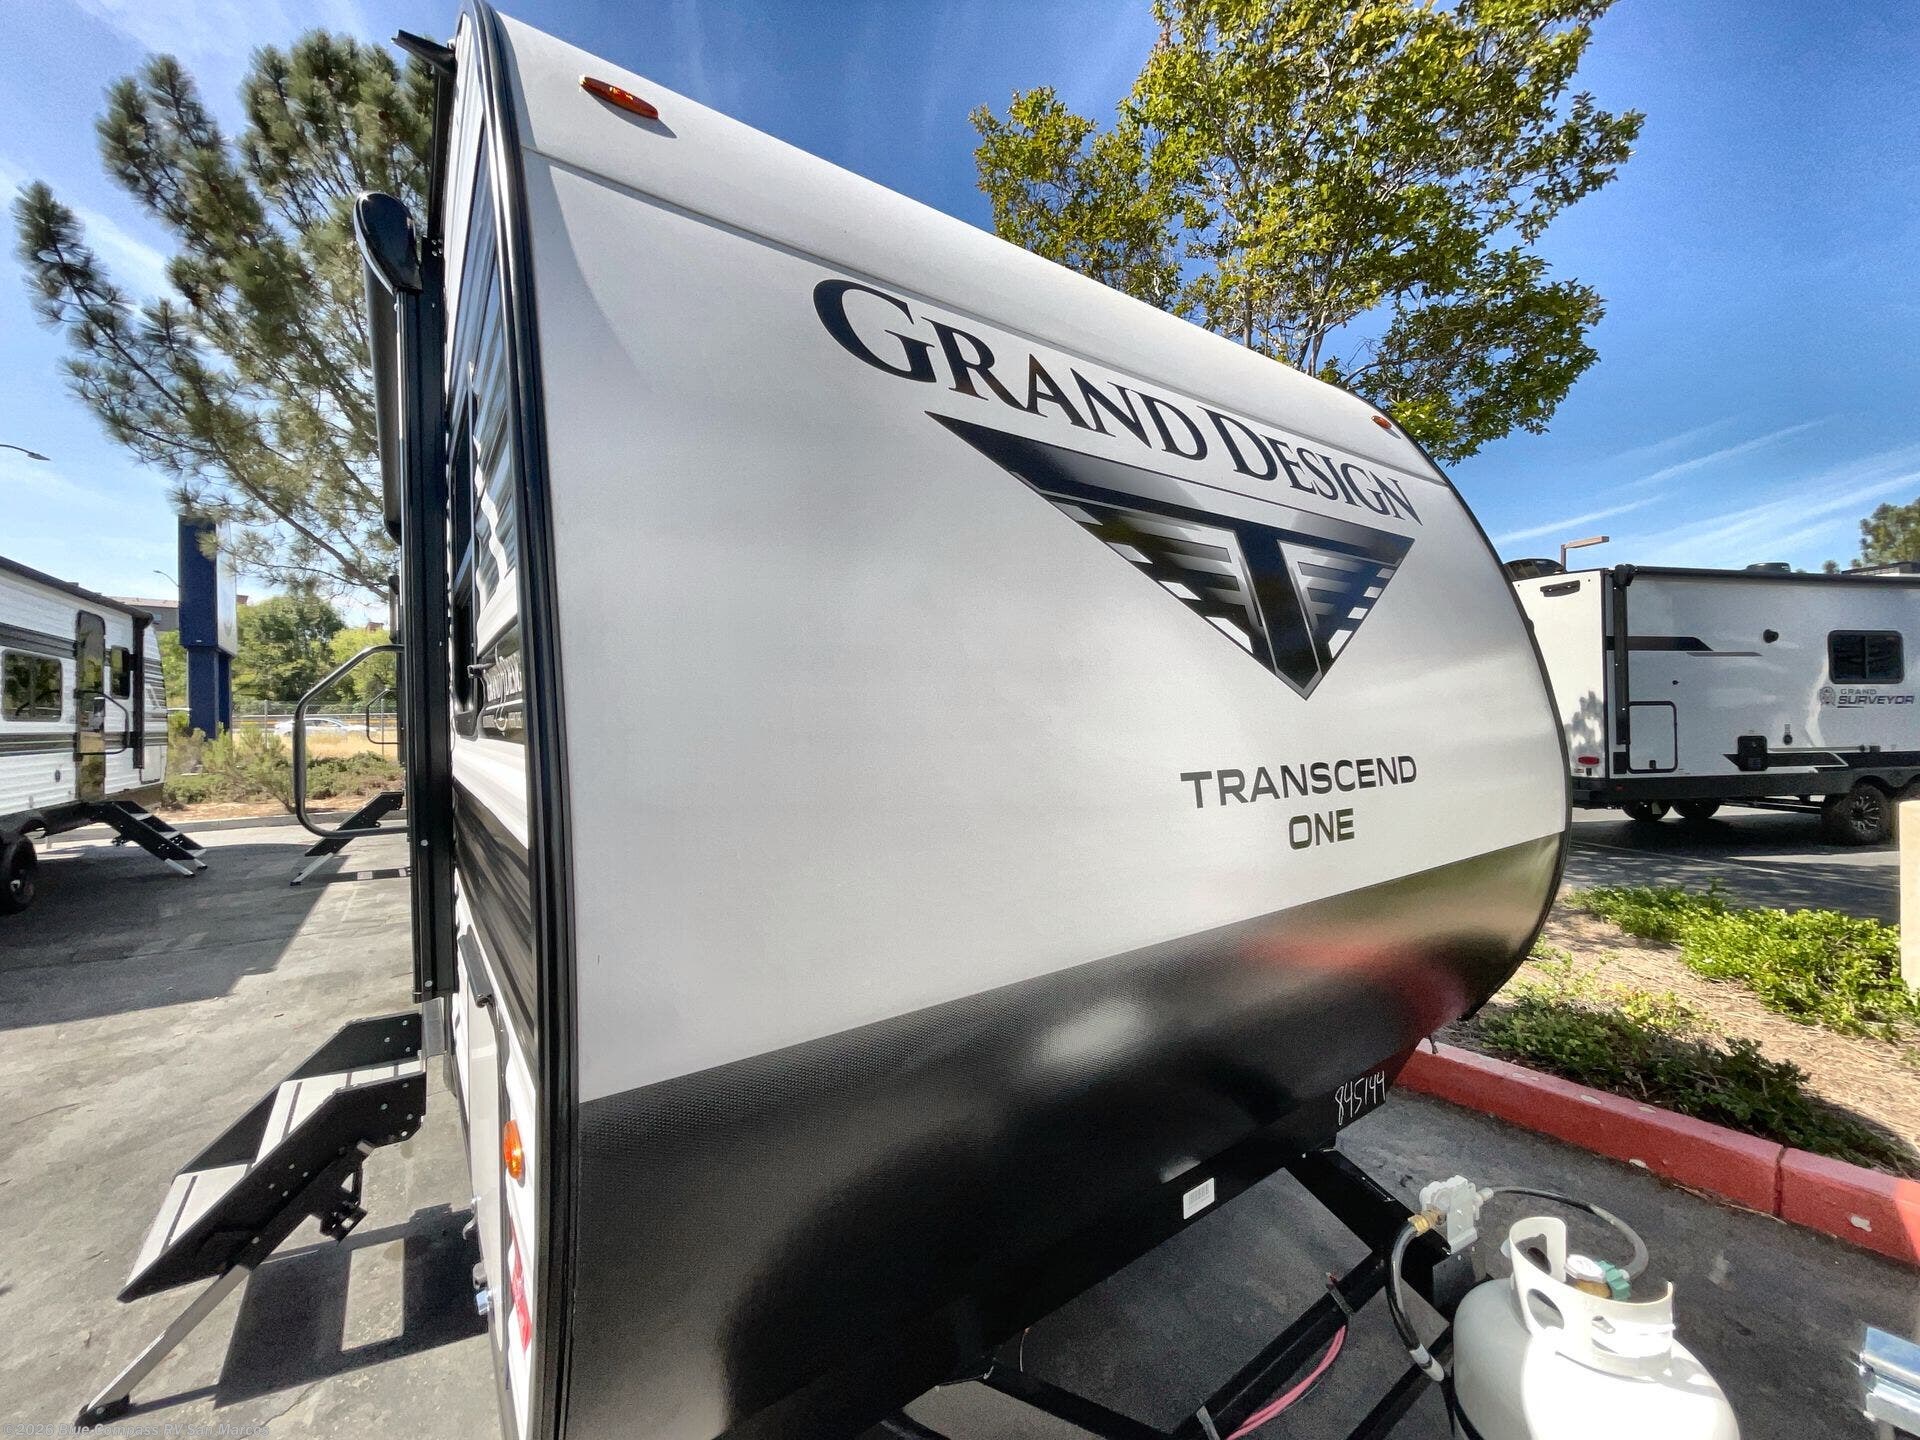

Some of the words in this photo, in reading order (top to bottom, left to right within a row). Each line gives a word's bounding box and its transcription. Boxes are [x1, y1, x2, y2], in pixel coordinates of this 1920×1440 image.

[813, 278, 1209, 461] GRAND
[1196, 405, 1424, 527] DESIGN
[1838, 695, 1916, 705] SURVEYOR
[1180, 755, 1417, 809] TRANSCEND
[1288, 807, 1355, 851] ONE
[1334, 1069, 1386, 1126] 845144
